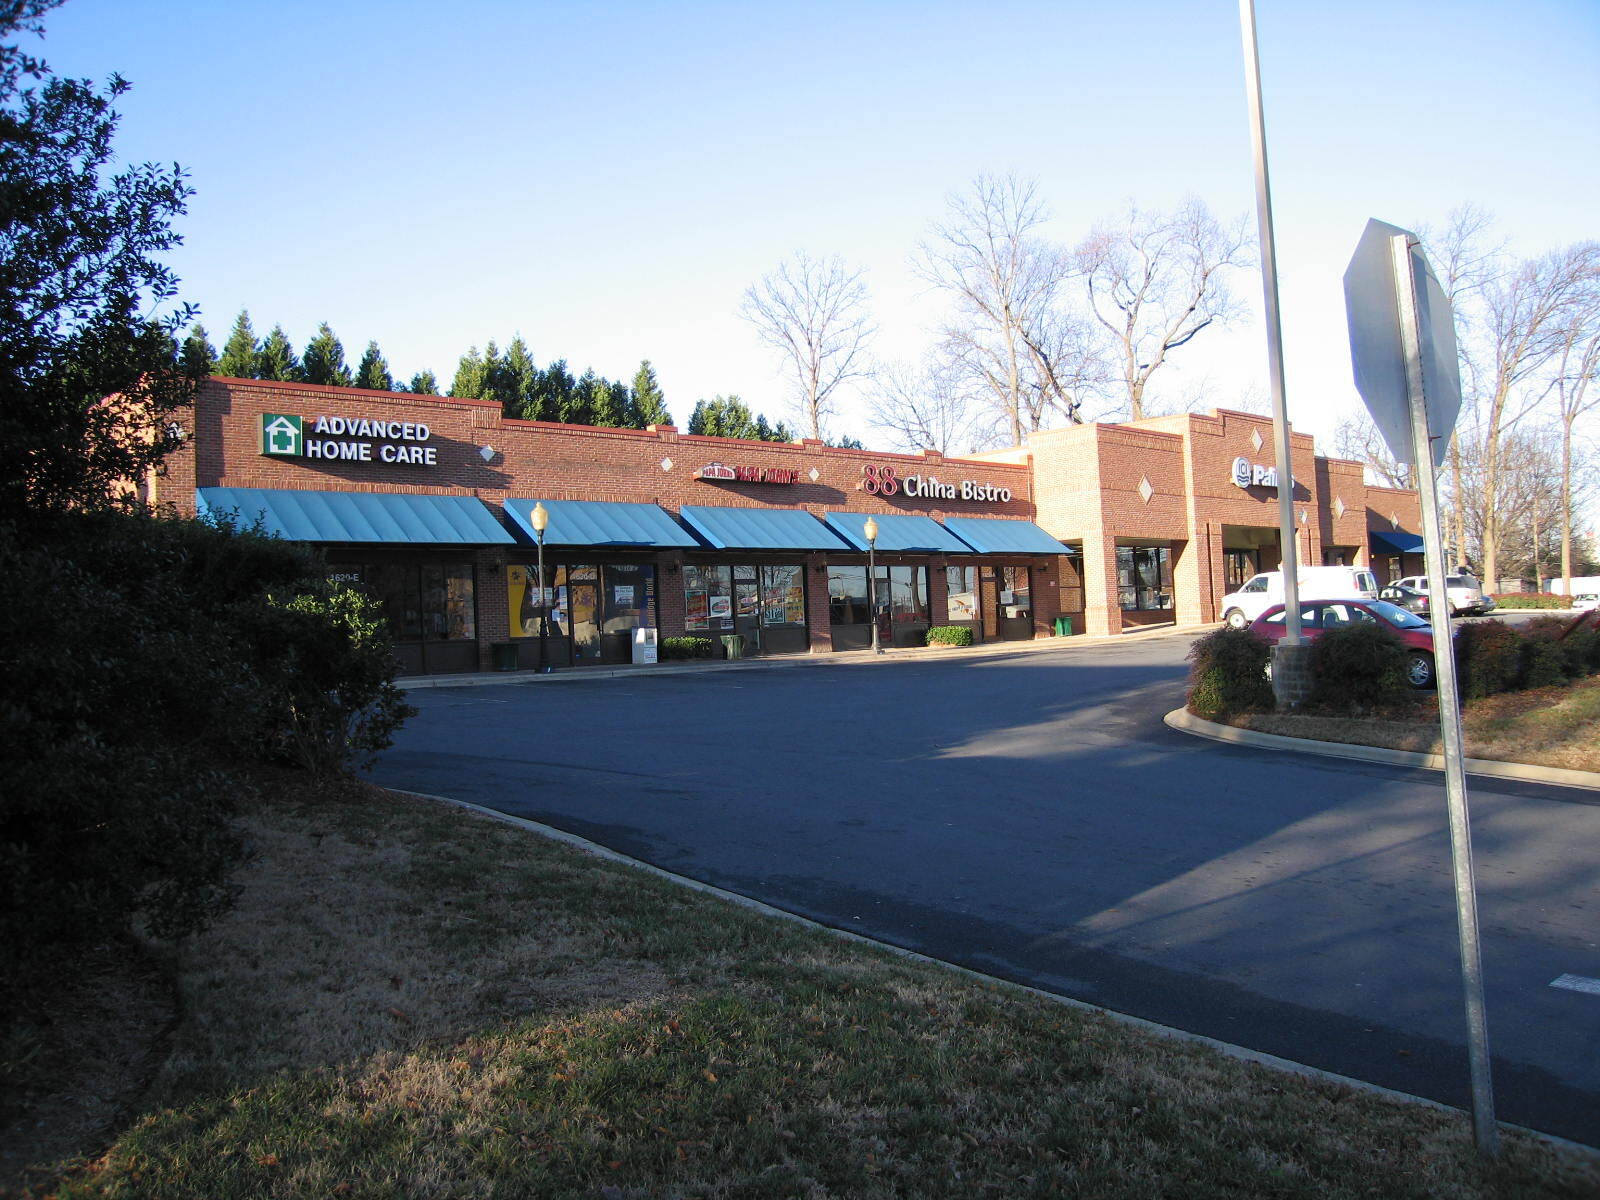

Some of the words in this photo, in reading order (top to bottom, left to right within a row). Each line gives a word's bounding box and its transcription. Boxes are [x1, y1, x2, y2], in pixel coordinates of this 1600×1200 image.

[314, 415, 430, 441] ADVANCED
[306, 439, 371, 462] HOME
[379, 444, 437, 466] CARE
[735, 466, 761, 482] PAPA
[765, 467, 800, 484] JOHN'S
[862, 464, 898, 496] 88
[903, 474, 956, 499] China
[960, 480, 1011, 503] Bistro
